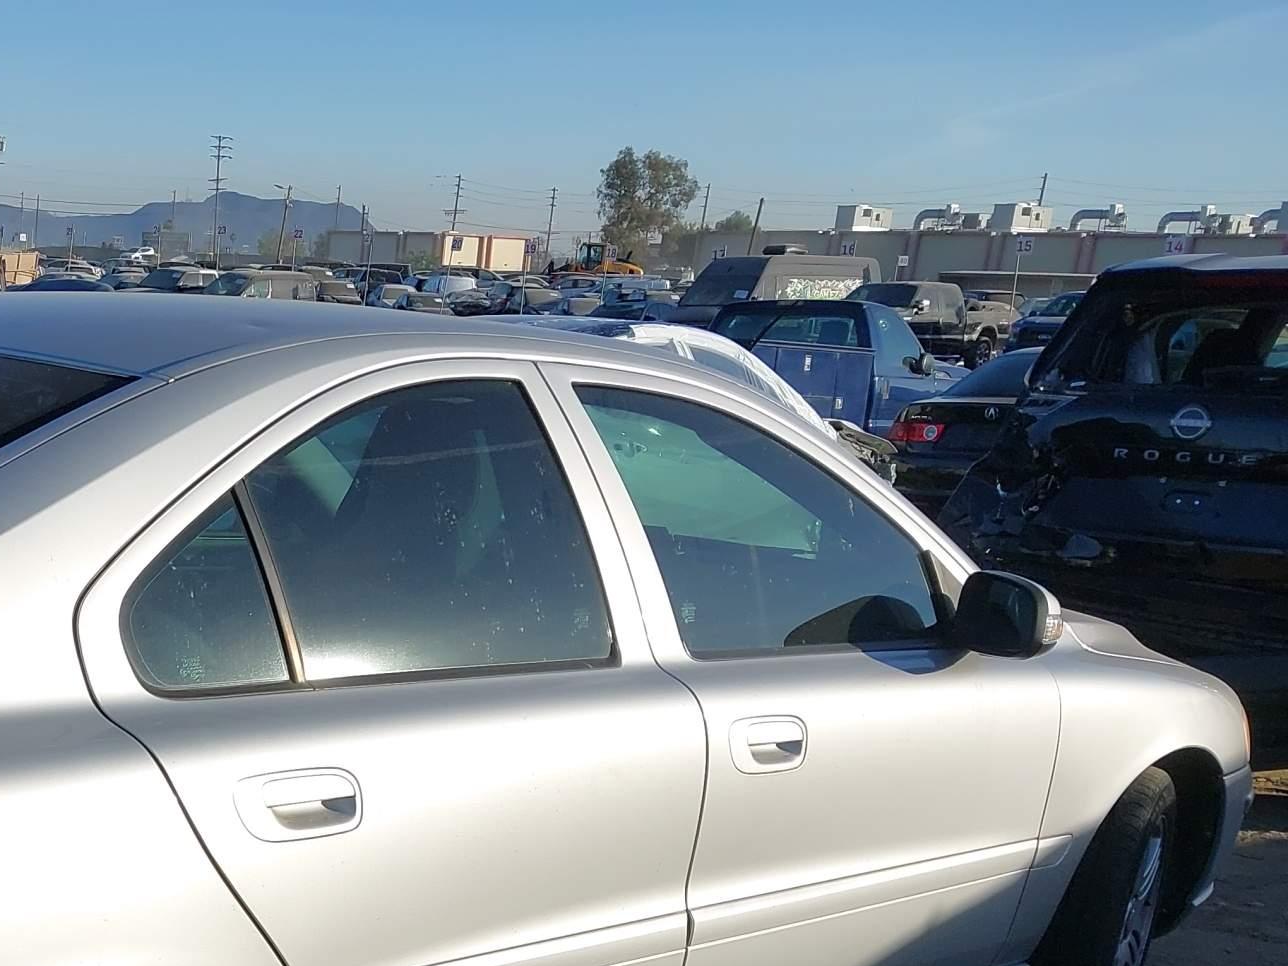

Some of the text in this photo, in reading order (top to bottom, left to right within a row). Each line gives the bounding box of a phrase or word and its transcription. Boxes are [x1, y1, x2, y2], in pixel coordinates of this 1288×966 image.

[217, 226, 227, 234] 23
[294, 230, 303, 239] 22
[452, 239, 462, 249] 20
[525, 244, 536, 254] 19
[1016, 240, 1032, 252] 15
[1166, 240, 1183, 253] 14
[607, 248, 617, 258] 18
[841, 244, 855, 255] 16
[1113, 447, 1258, 466] ROGUE
